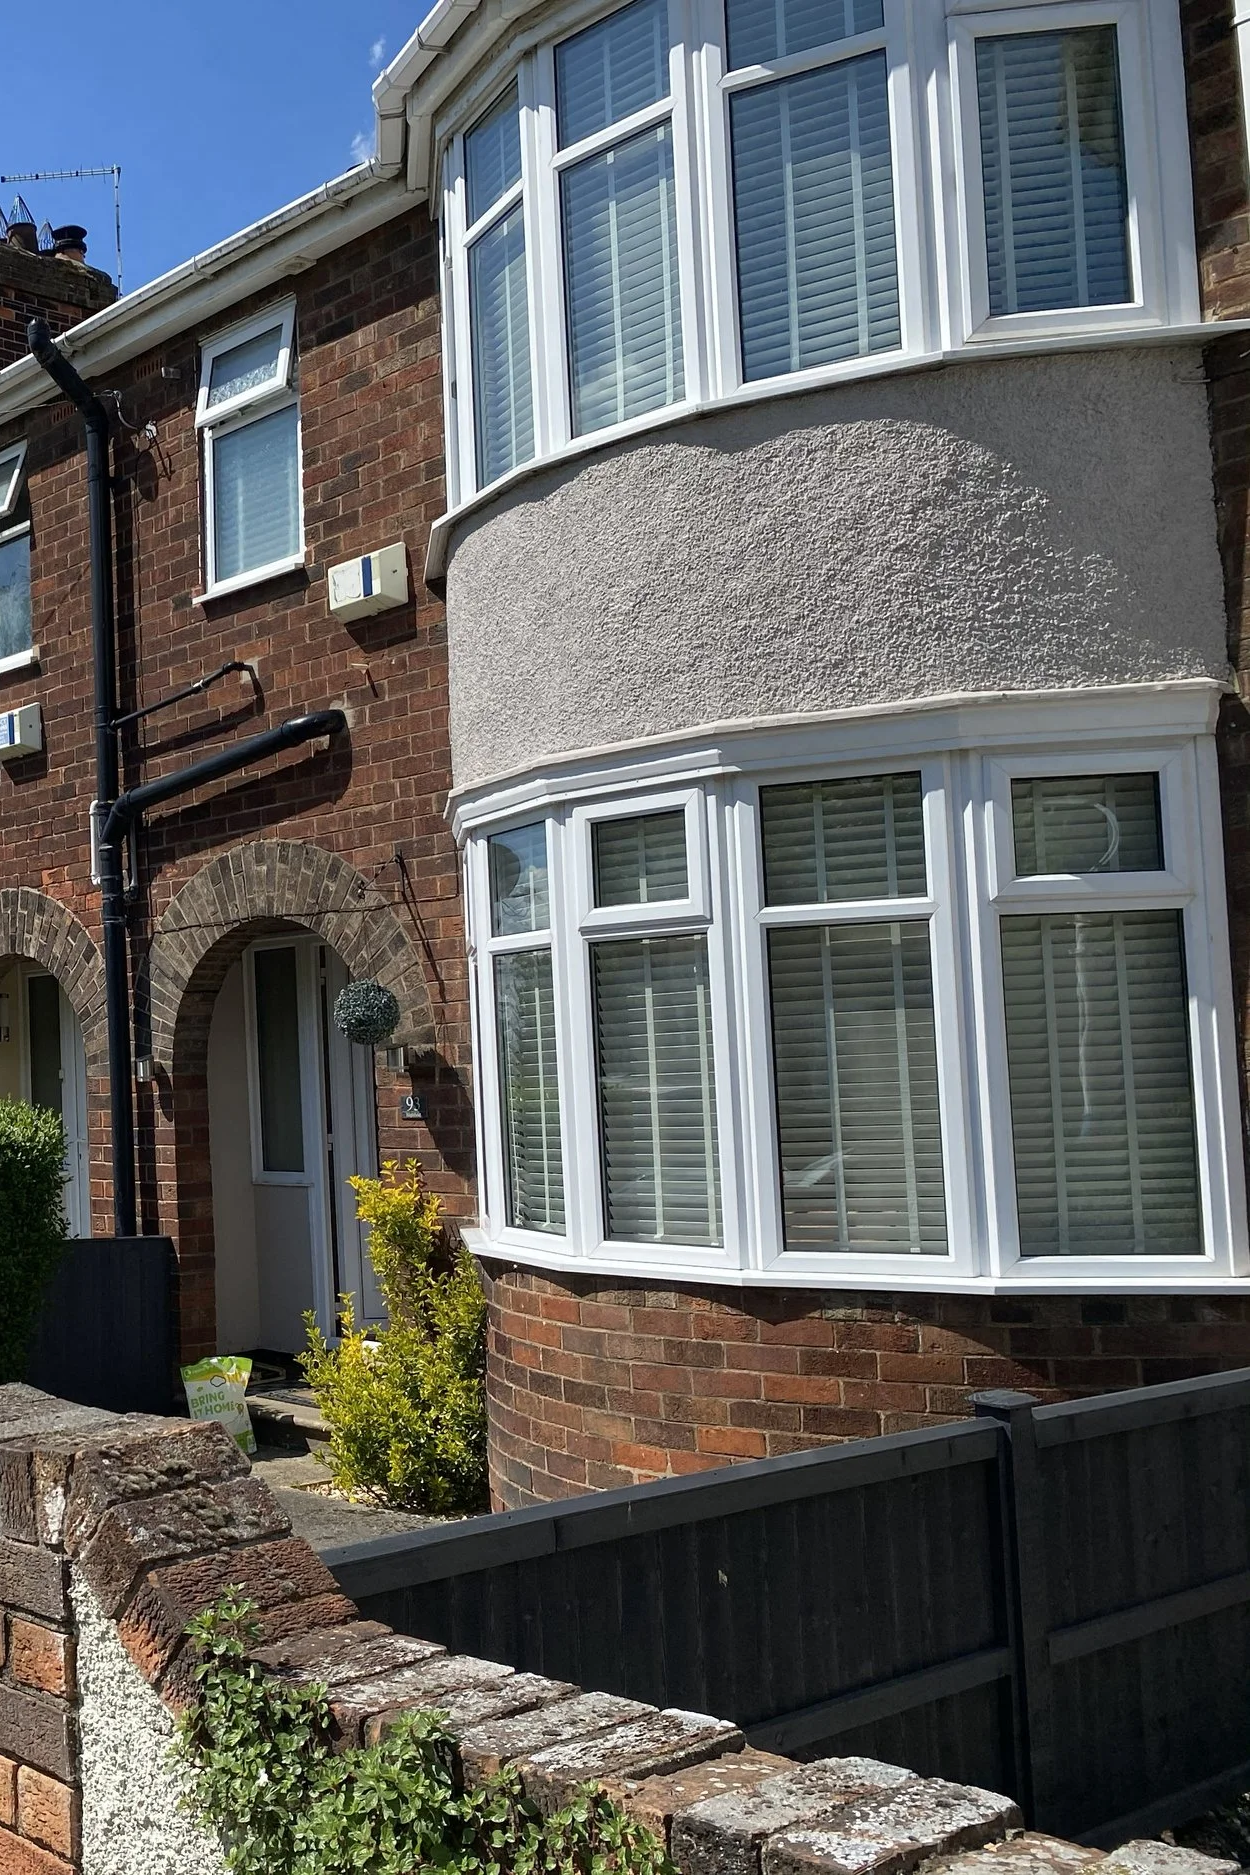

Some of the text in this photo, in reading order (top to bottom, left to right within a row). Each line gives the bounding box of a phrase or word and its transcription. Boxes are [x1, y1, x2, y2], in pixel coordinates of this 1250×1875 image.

[405, 1096, 421, 1112] 93
[191, 1391, 225, 1408] BRING
[205, 1401, 236, 1415] HOME
